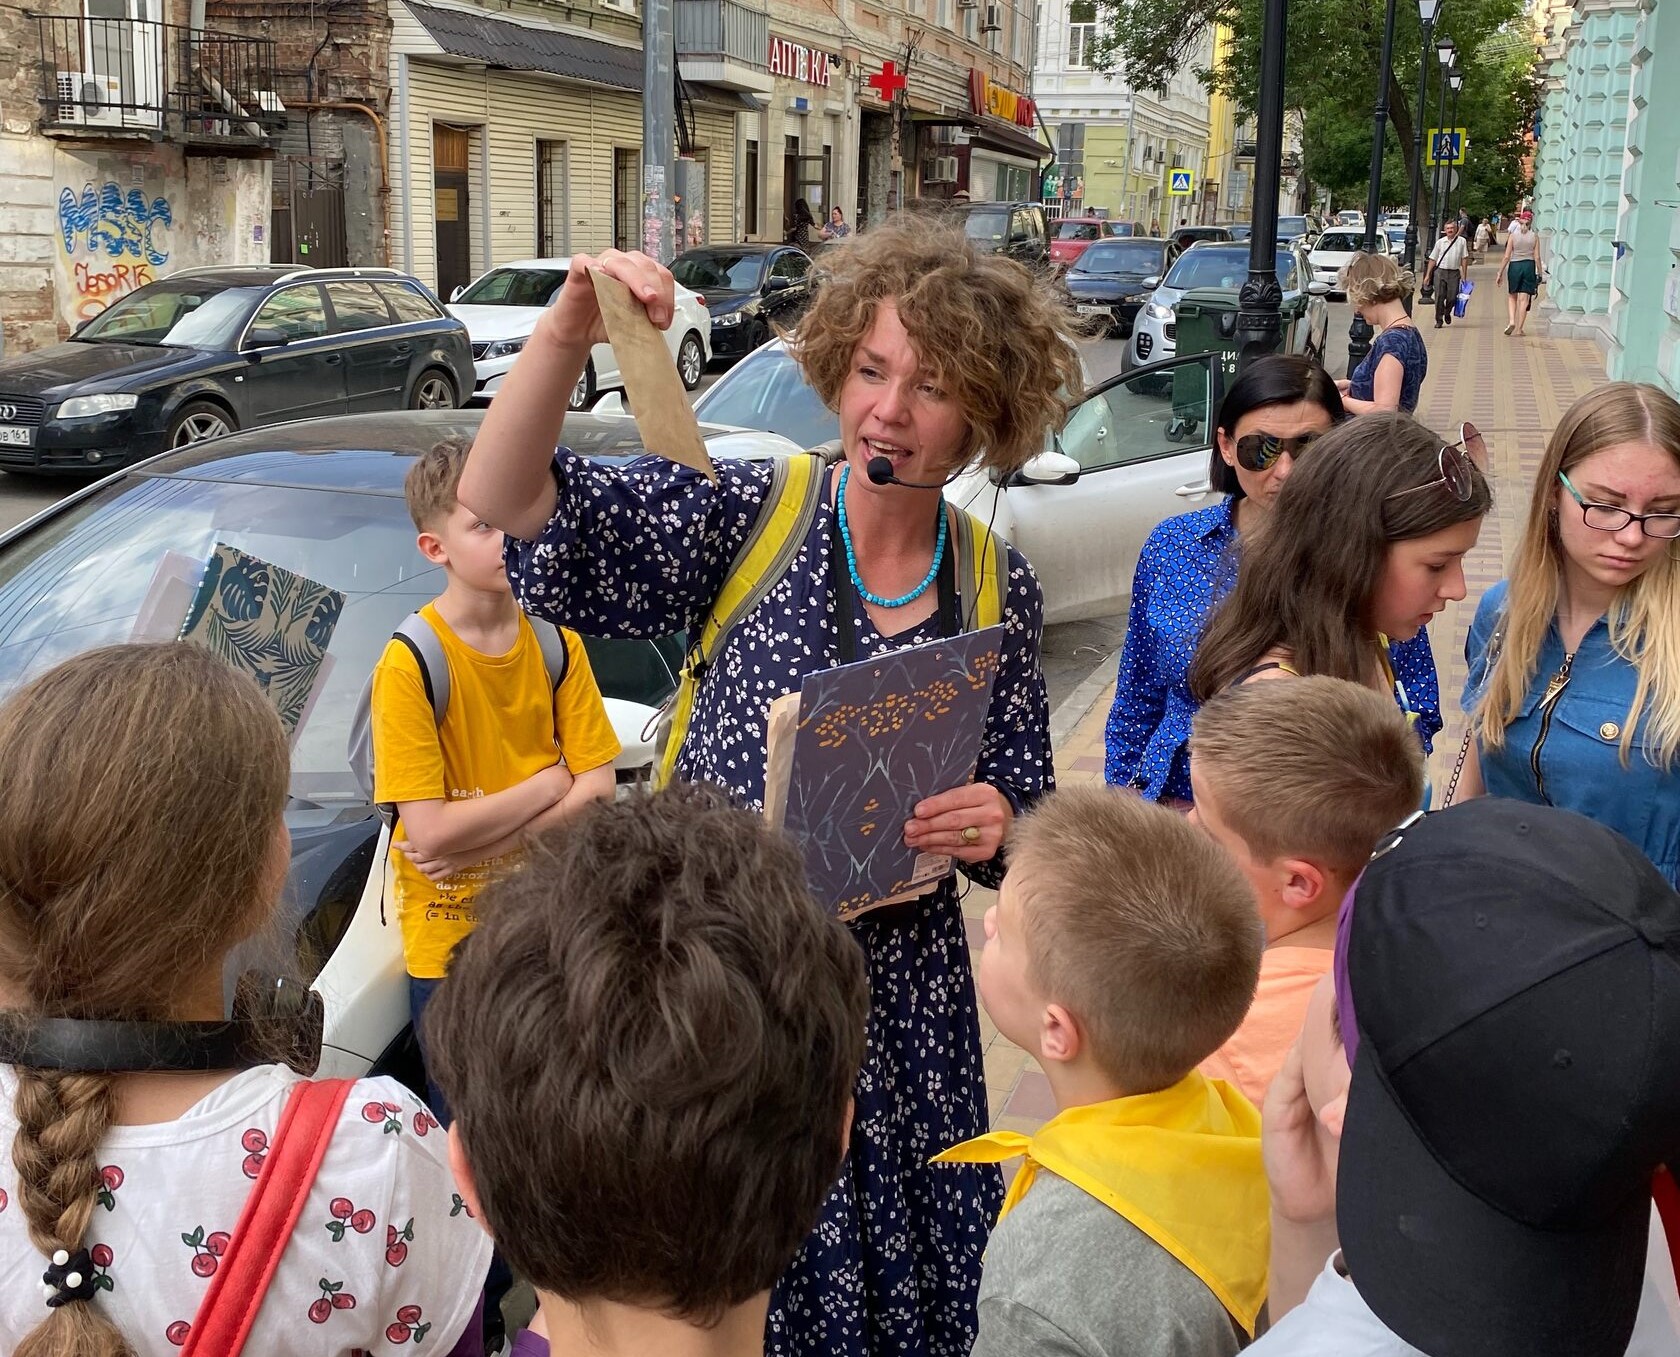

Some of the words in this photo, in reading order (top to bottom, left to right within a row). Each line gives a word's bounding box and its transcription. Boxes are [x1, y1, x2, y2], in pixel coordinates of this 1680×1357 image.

[769, 37, 831, 87] АПТЕКА
[11, 429, 27, 440] 161
[444, 911, 460, 921] in
